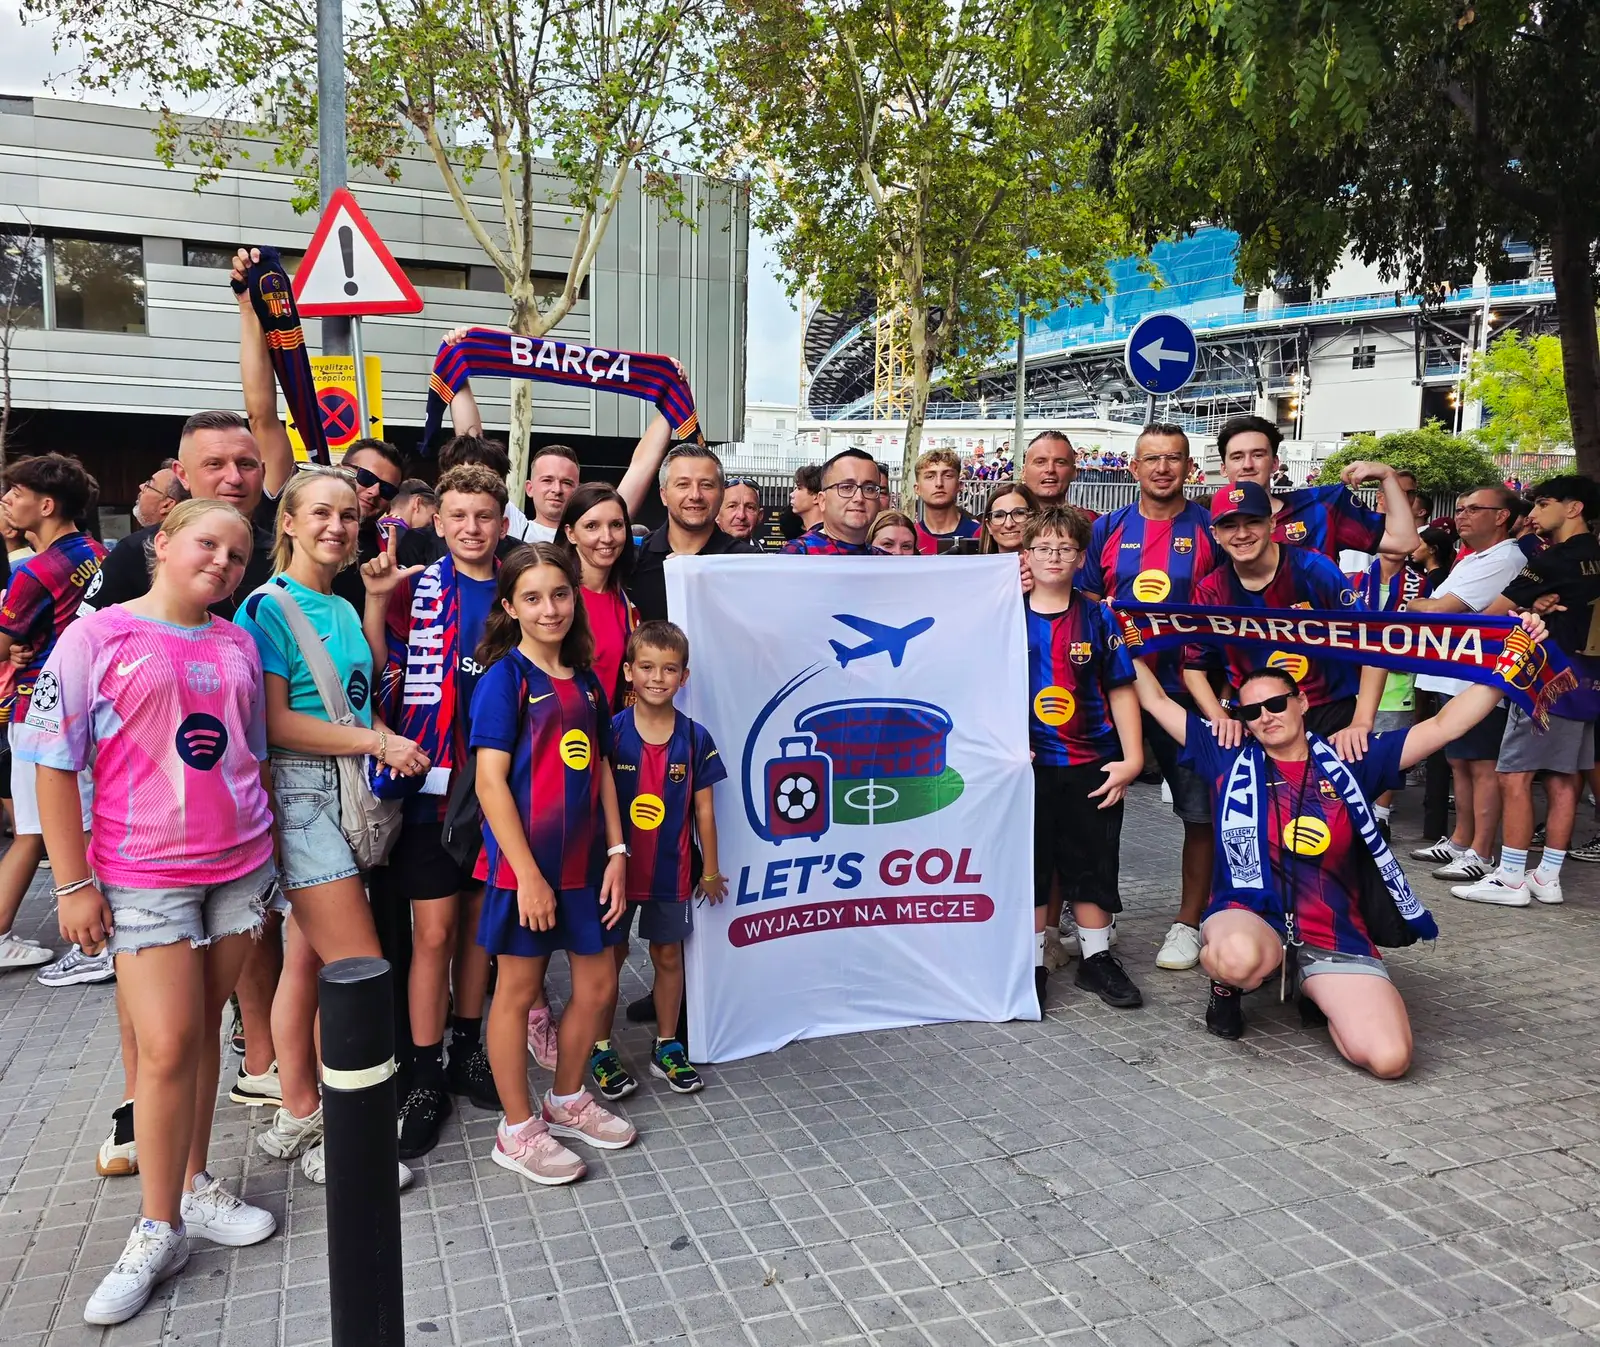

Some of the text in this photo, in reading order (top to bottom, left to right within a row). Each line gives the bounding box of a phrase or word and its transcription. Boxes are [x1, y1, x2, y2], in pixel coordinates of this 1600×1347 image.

[510, 335, 631, 383] BARÇA
[69, 555, 106, 588] CUBA
[1145, 612, 1483, 665] FC BARCELONA
[403, 624, 444, 705] UEFA
[460, 656, 487, 676] Sp
[617, 764, 636, 772] BARÇA
[736, 848, 982, 906] LET'S GOL
[743, 900, 976, 940] WYJAZDY NA MECZE
